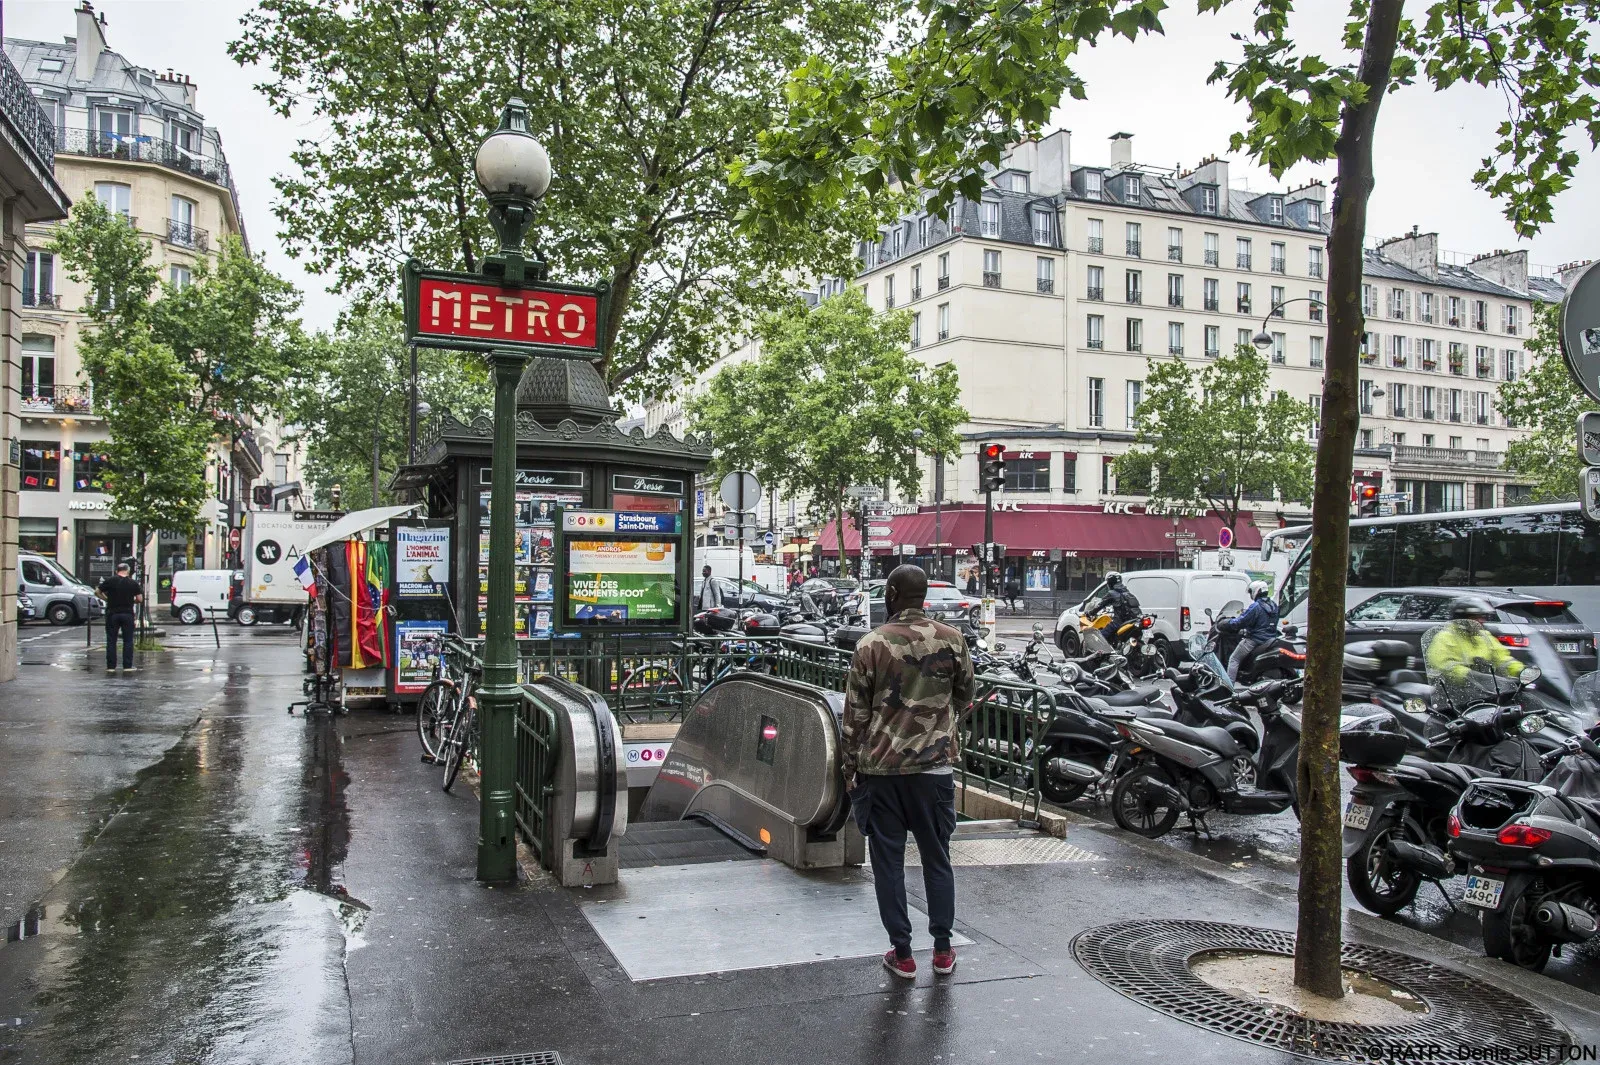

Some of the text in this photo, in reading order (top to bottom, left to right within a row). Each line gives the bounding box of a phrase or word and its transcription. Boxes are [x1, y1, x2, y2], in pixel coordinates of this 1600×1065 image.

[431, 288, 586, 339] METRO
[516, 471, 555, 484] Presse
[633, 478, 665, 491] Presse
[992, 500, 1023, 512] KFC
[1103, 501, 1135, 515] KFC
[618, 514, 657, 525] Strasbourg
[618, 522, 659, 531] Saint-Denis
[398, 532, 449, 543] Magazine
[573, 580, 619, 589] VIVEZ DES
[573, 588, 645, 598] MOMENTS FOOT
[582, 863, 594, 877] A
